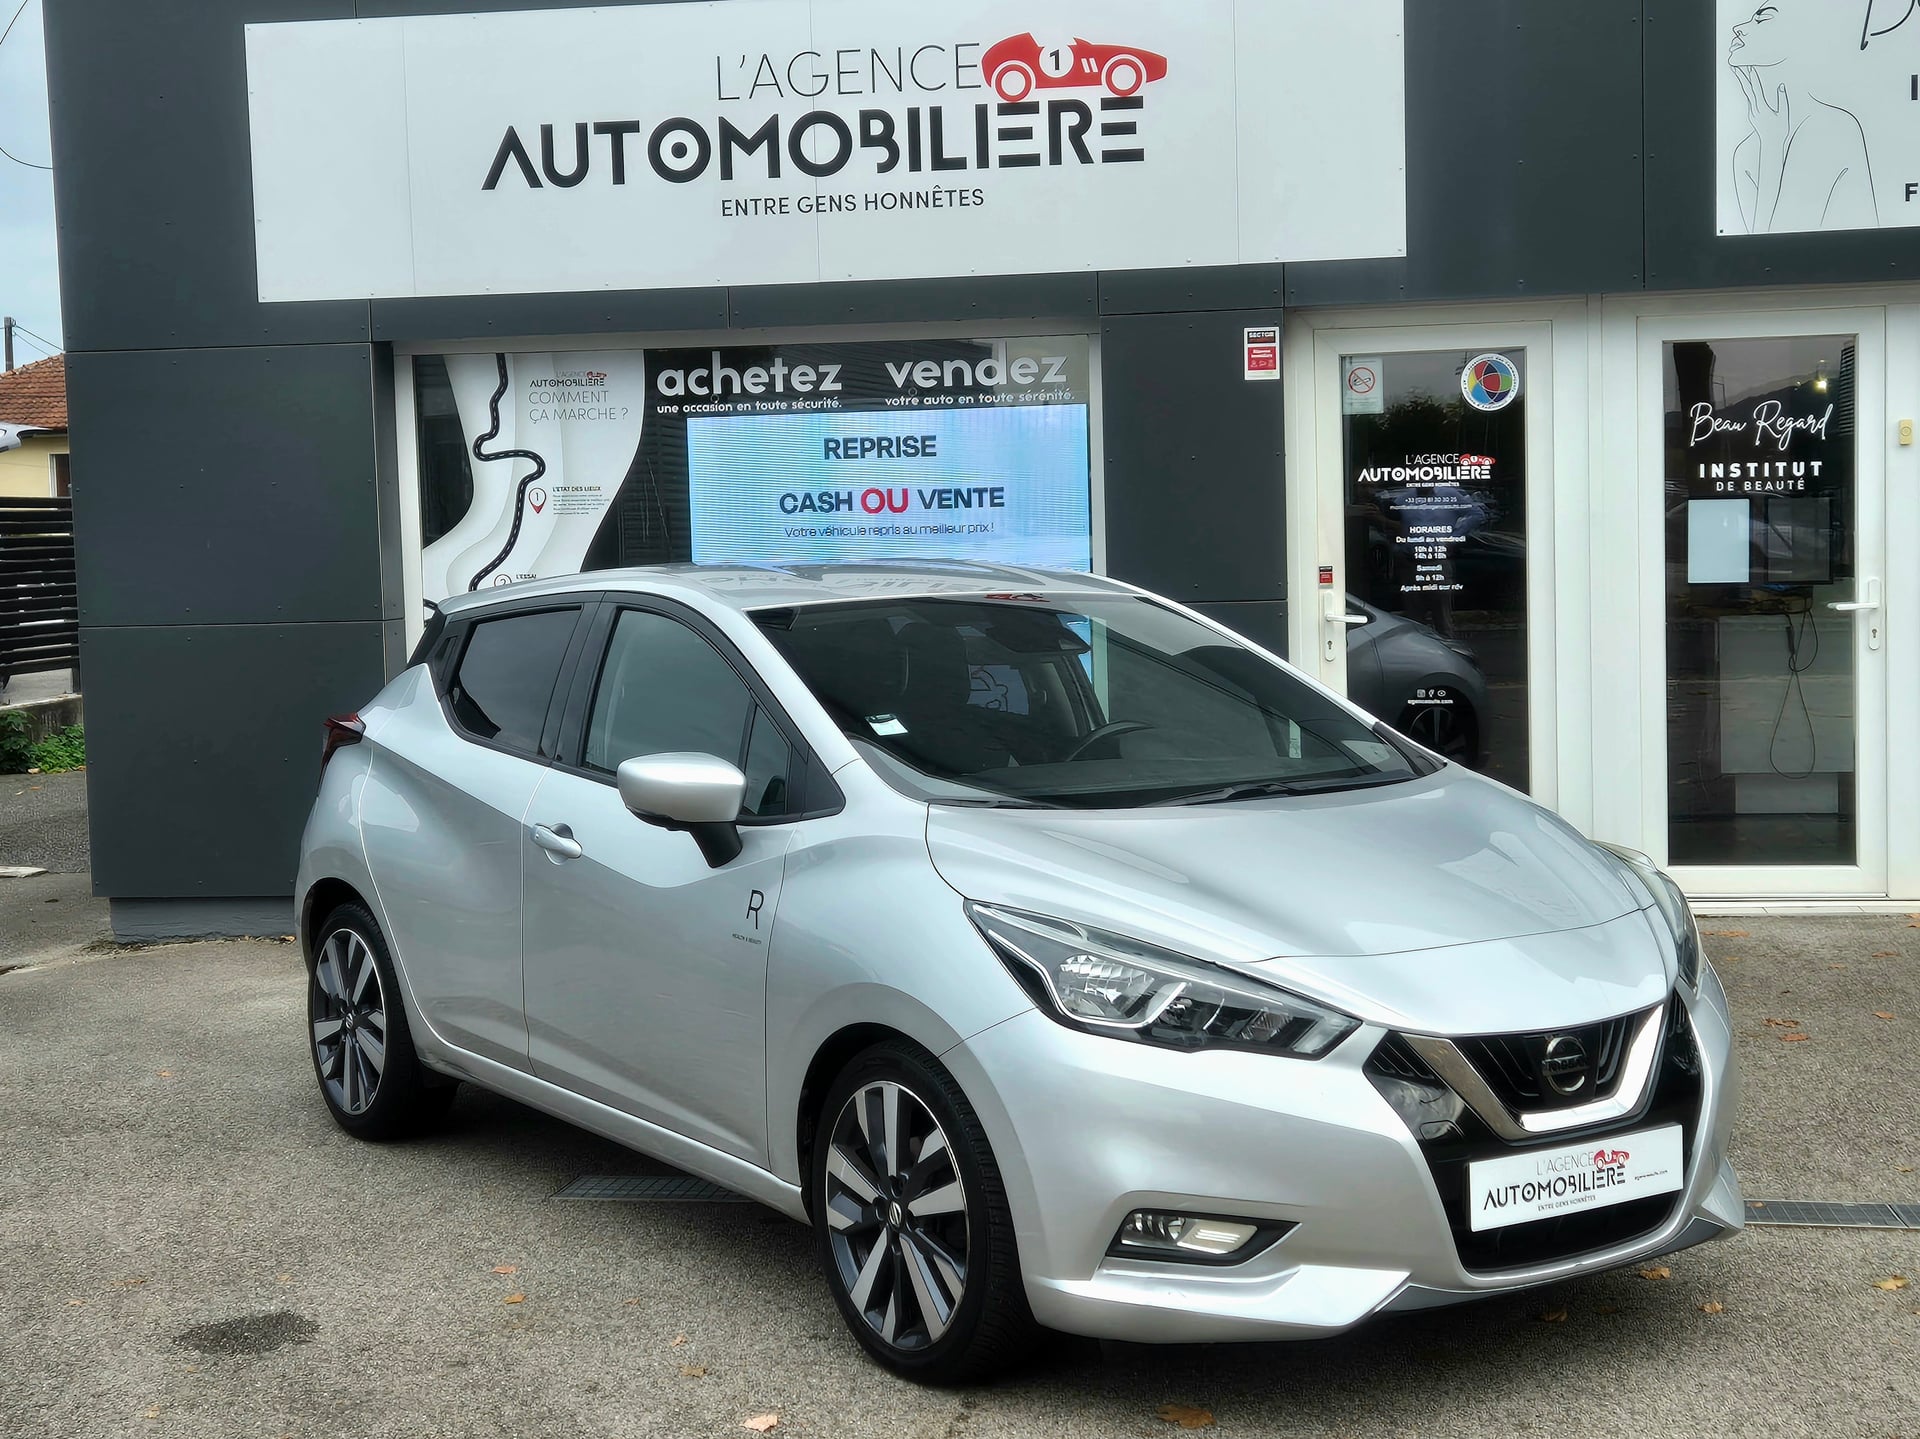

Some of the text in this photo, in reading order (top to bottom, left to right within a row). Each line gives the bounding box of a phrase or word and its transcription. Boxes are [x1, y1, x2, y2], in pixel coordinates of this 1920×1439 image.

[716, 43, 981, 101] L'AGENCE
[721, 185, 985, 217] ENTRE GENS HONNÊTES
[656, 350, 842, 397] achetez
[884, 343, 1067, 388] vendez
[528, 390, 608, 405] COMMENT
[657, 396, 842, 414] une occasion en toute sécurité.
[885, 388, 1075, 406] votre auto en toute sérénité.
[529, 406, 629, 425] ÇA MARCHE ?
[1689, 400, 1834, 451] Beau Regard
[823, 435, 937, 460] REPRISE
[1405, 453, 1460, 465] L'AGENCE
[1699, 461, 1823, 478] INSTITUT
[1716, 478, 1805, 491] DE BEAUTÉ
[779, 486, 1005, 514] CASH OU VENTE
[784, 526, 817, 538] Votre
[818, 525, 867, 537] véhicule
[868, 523, 901, 536] repris
[902, 525, 918, 535] au
[919, 523, 966, 535] meilleur
[1409, 525, 1453, 534] HORAIRES
[1536, 1151, 1595, 1176] L'AGENCE
